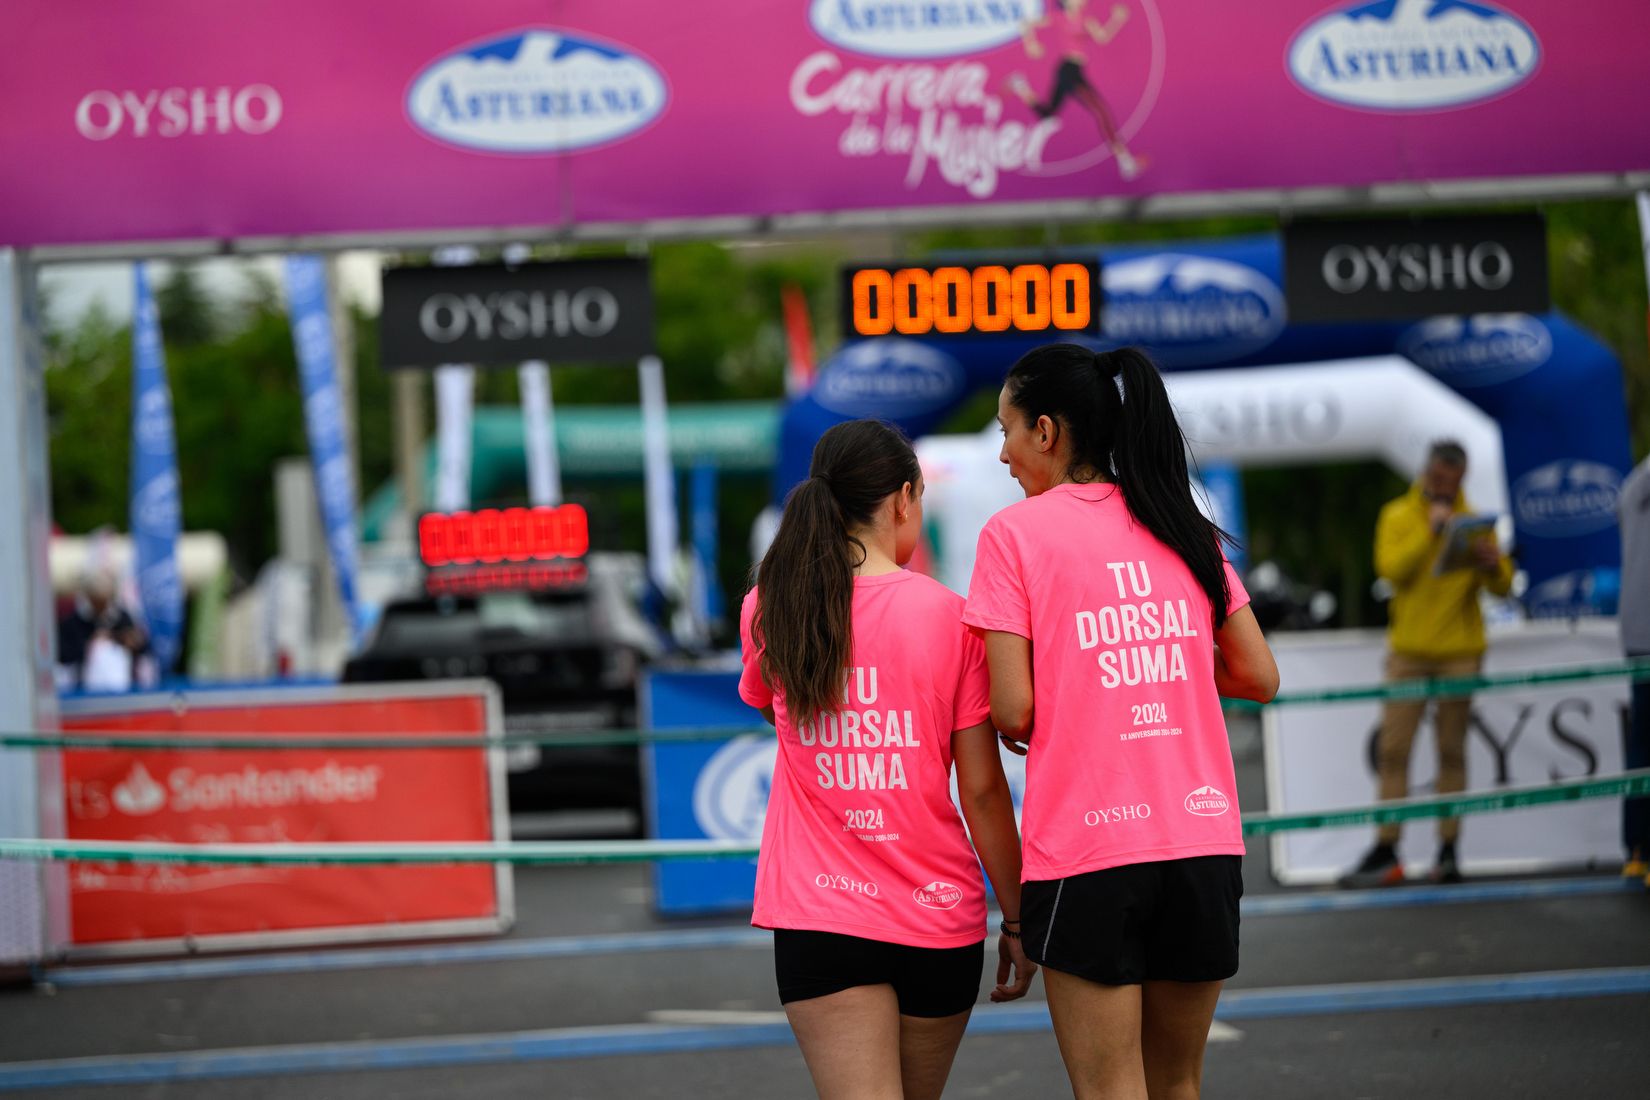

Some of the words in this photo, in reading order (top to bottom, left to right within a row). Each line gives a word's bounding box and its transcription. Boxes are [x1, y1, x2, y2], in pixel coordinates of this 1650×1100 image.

[75, 83, 283, 140] OYSHO
[1321, 240, 1513, 294] OYSHO
[419, 286, 620, 343] OYSHO
[1107, 560, 1152, 599] TU
[1076, 599, 1198, 650] DORSAL
[1098, 643, 1188, 689] SUMA
[798, 709, 920, 748] DORSAL
[1131, 702, 1167, 726] 2024
[168, 760, 382, 813] Santander
[815, 753, 908, 791] SUMA
[845, 808, 885, 830] 2024
[1084, 803, 1151, 826] OYSHO
[815, 873, 879, 897] OYSHO
